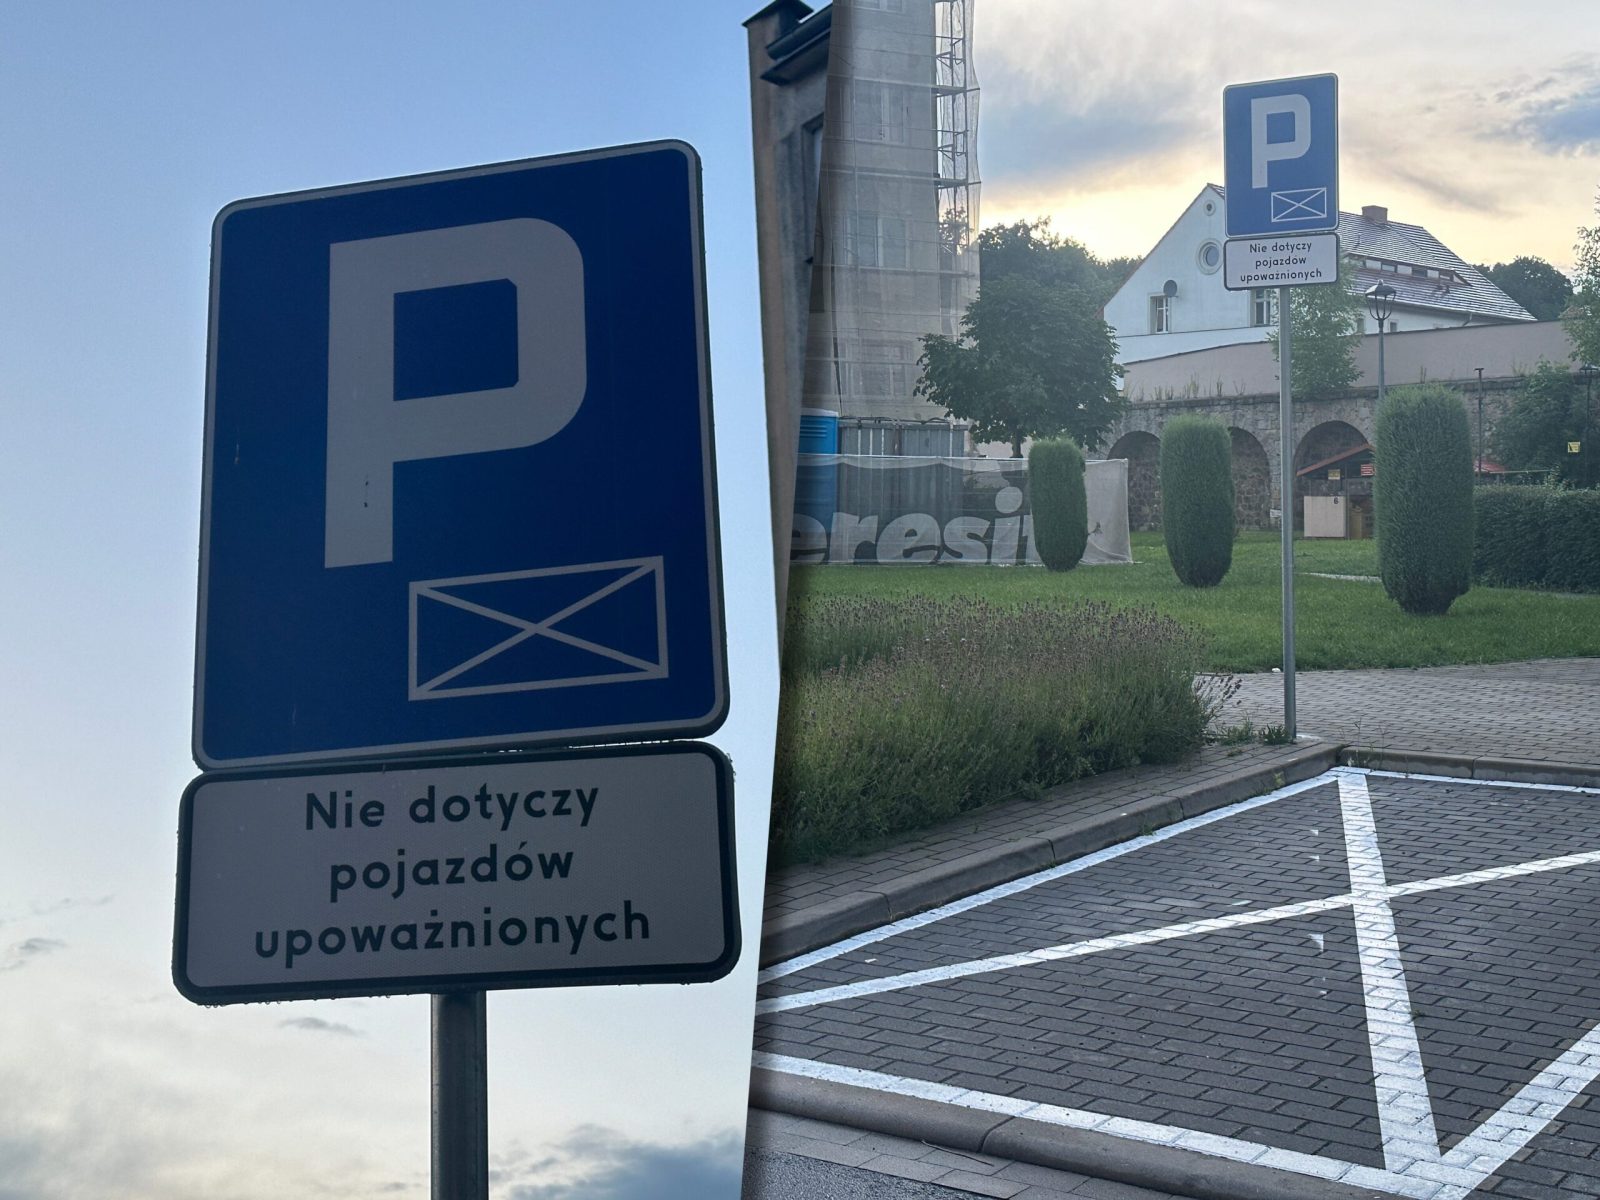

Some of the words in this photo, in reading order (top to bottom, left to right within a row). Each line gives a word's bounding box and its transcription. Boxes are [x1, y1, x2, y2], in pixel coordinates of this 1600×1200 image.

[1250, 93, 1312, 189] P
[1240, 268, 1322, 285] upoważnionych
[1249, 243, 1268, 254] Nie
[1270, 241, 1313, 254] dotyczy
[1254, 255, 1307, 270] pojazdów
[324, 217, 588, 568] P
[305, 788, 386, 832] Nie
[408, 781, 601, 833] dotyczy
[329, 840, 576, 905] pojazdów
[254, 898, 652, 971] upoważnionych
